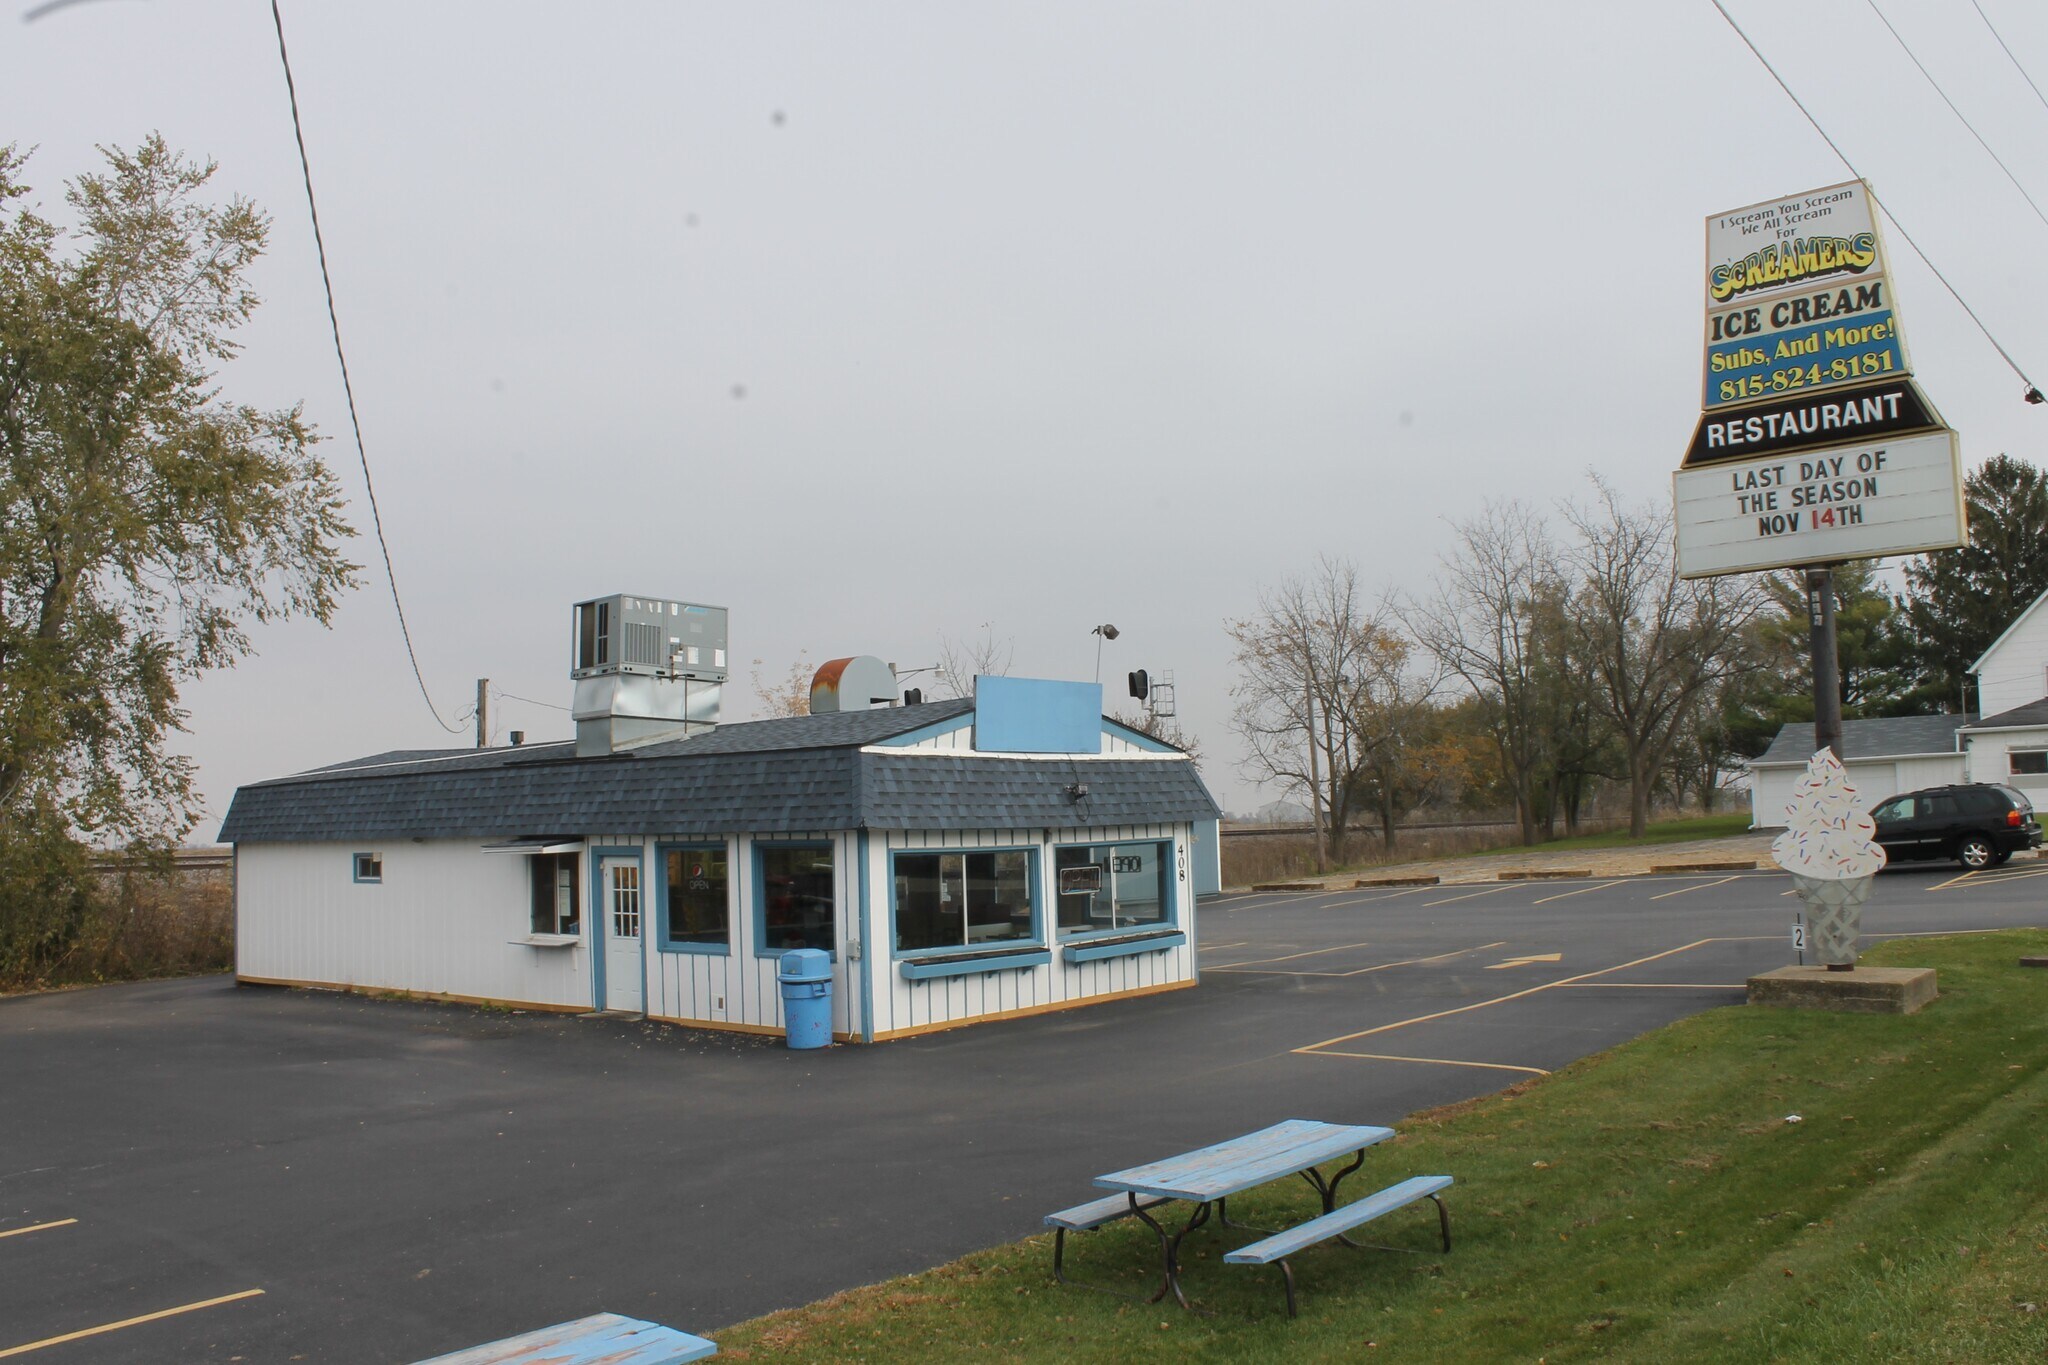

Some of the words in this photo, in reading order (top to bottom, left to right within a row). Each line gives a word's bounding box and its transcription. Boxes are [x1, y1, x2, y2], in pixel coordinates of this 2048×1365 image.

[1721, 219, 1725, 229] I
[1730, 208, 1774, 228] Scream
[1778, 203, 1800, 216] You
[1805, 190, 1853, 209] Scream
[1742, 224, 1760, 235] We
[1763, 219, 1781, 231] All
[1785, 207, 1832, 225] Scream
[1776, 227, 1798, 239] For
[1711, 308, 1762, 341] ICE
[1770, 282, 1883, 329] CREAM
[1711, 348, 1771, 373] Subs,
[1774, 332, 1820, 360] And
[1825, 317, 1895, 350] More!
[1719, 349, 1894, 401] 815-824-8181
[1707, 392, 1903, 448] RESTAURANT
[1733, 466, 1785, 491] LAST
[1800, 457, 1844, 482] DAY
[1857, 450, 1887, 473] OF
[1737, 491, 1778, 515] THE
[1791, 477, 1877, 508] SEASON
[1759, 512, 1799, 536] NOV
[1812, 504, 1862, 530] 14TH
[1796, 928, 1803, 946] 2
